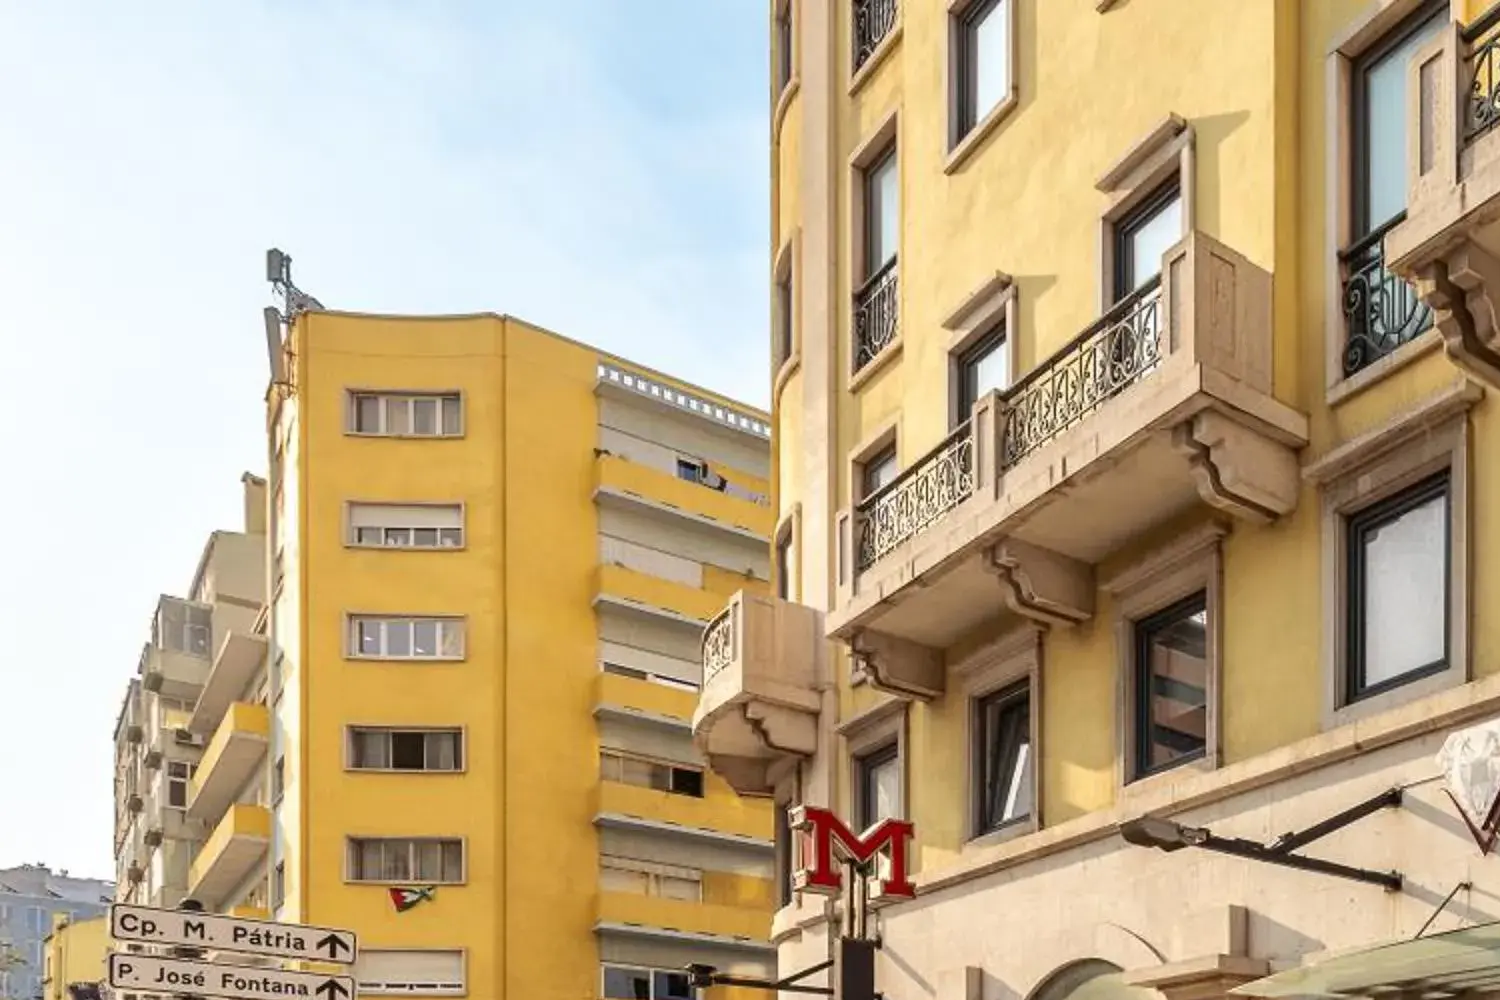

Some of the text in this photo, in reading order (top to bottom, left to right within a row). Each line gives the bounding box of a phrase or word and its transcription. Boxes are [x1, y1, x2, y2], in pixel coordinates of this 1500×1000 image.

[120, 913, 306, 951] Cp. M. Pátria
[118, 963, 309, 996] P. José Fontana
